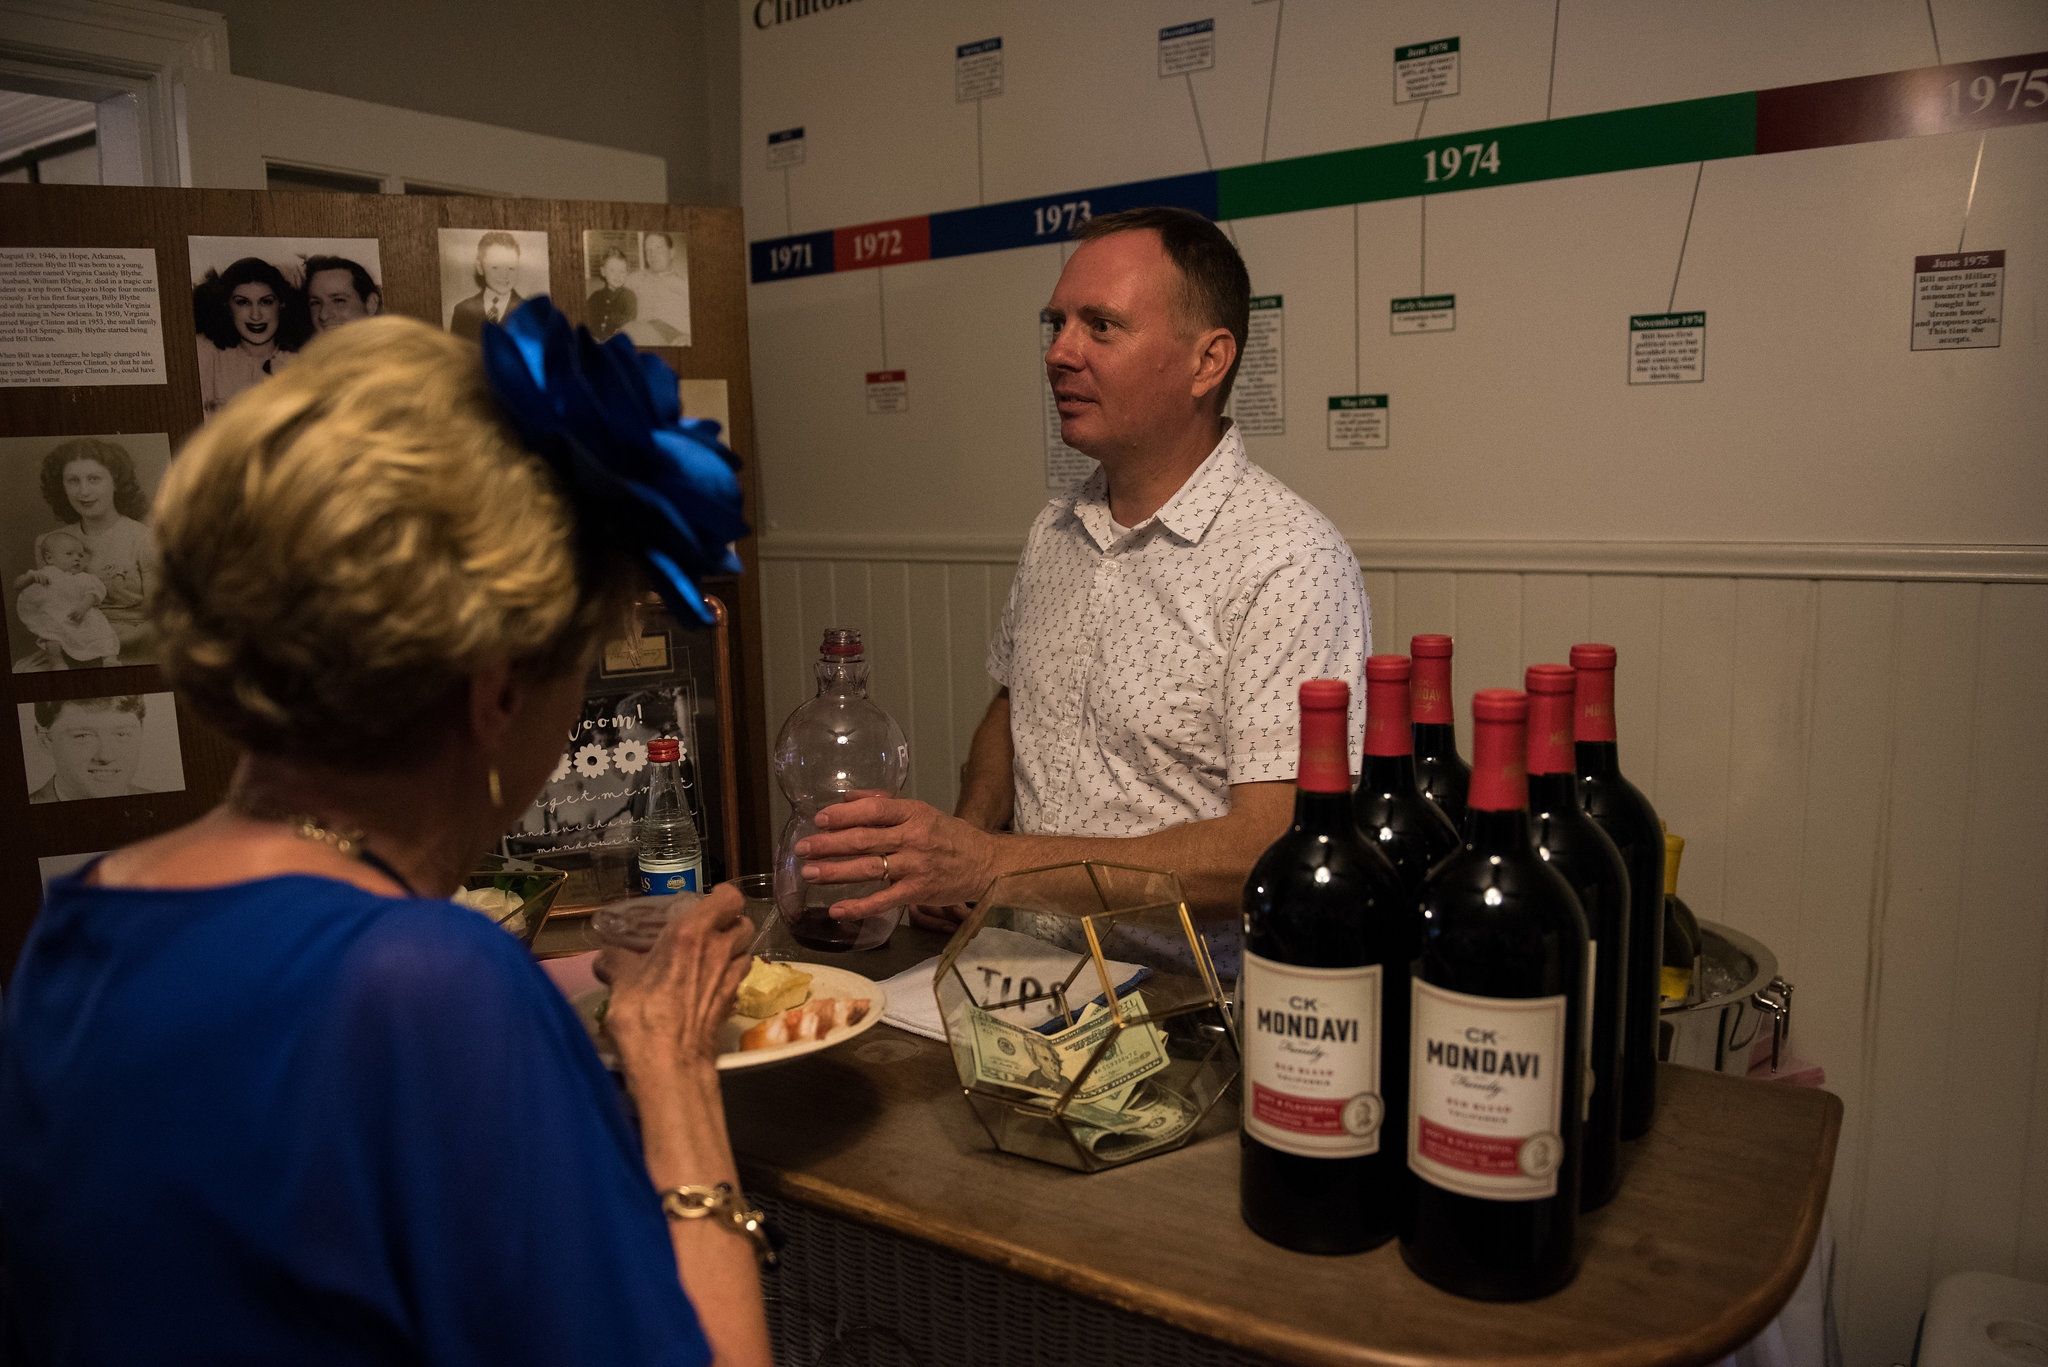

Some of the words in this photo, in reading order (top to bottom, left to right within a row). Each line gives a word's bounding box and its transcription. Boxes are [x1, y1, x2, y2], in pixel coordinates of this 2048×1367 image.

[1943, 67, 2048, 117] 1975
[1422, 140, 1501, 183] 1974
[1033, 200, 1093, 236] 1973
[769, 242, 813, 274] 1971
[853, 229, 902, 262] 1972
[1919, 275, 1936, 283] Bill
[1938, 274, 1962, 282] meets
[1965, 272, 1997, 281] Hillary
[1932, 258, 1960, 269] June
[1963, 255, 1990, 266] 1975
[1946, 282, 1978, 292] airport
[1933, 318, 1970, 328] proposes
[977, 966, 1064, 1016] TIPS
[1289, 995, 1318, 1012] CK
[1257, 1007, 1358, 1043] MONDAVI
[1465, 1027, 1496, 1044] CK
[1426, 1038, 1539, 1079] MONDAVI
